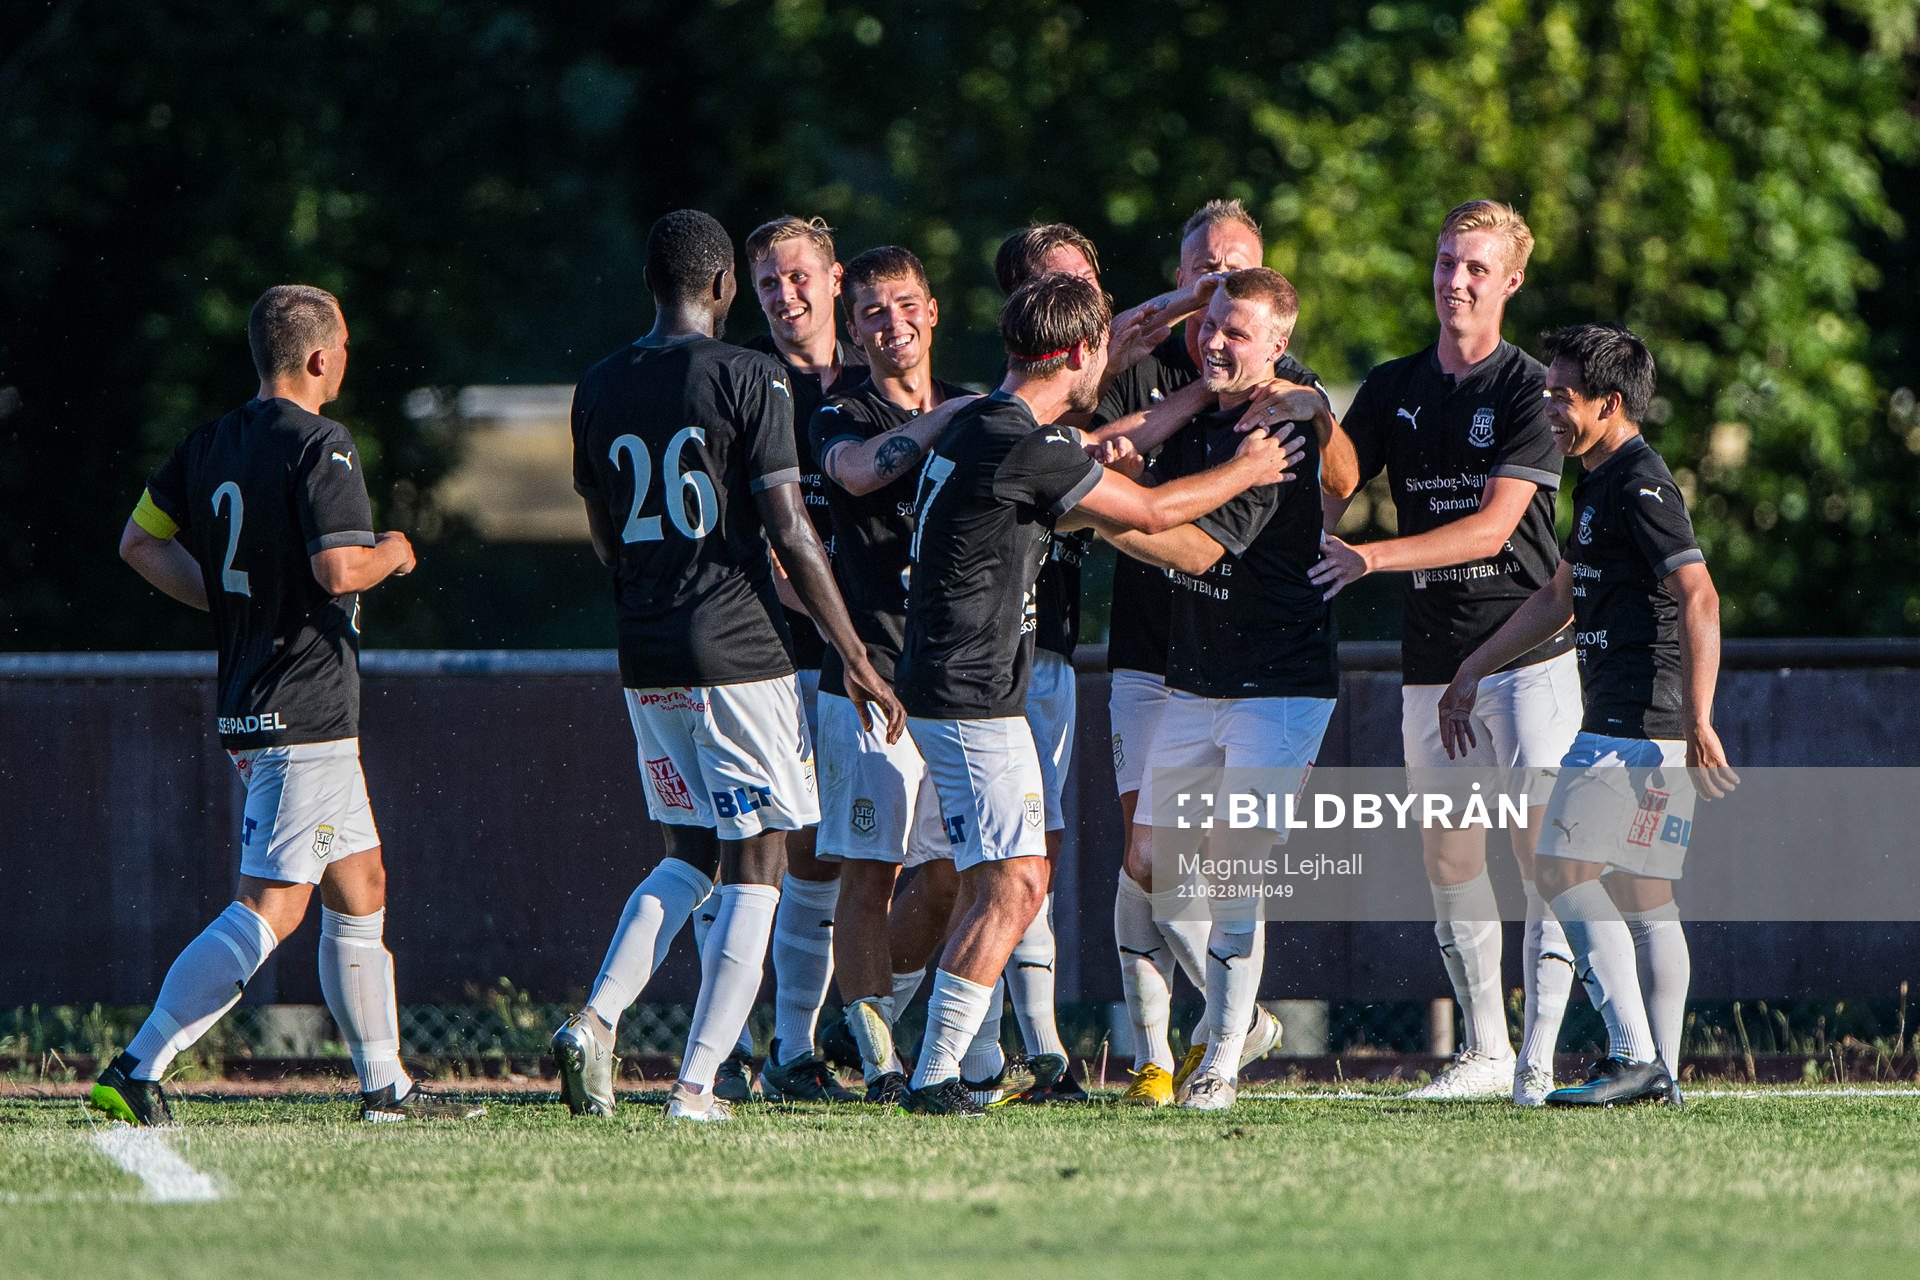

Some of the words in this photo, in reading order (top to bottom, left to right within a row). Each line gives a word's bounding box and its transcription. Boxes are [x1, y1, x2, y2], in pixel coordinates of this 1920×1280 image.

[211, 481, 251, 598] 2
[608, 426, 719, 544] 26
[712, 785, 772, 818] BLT
